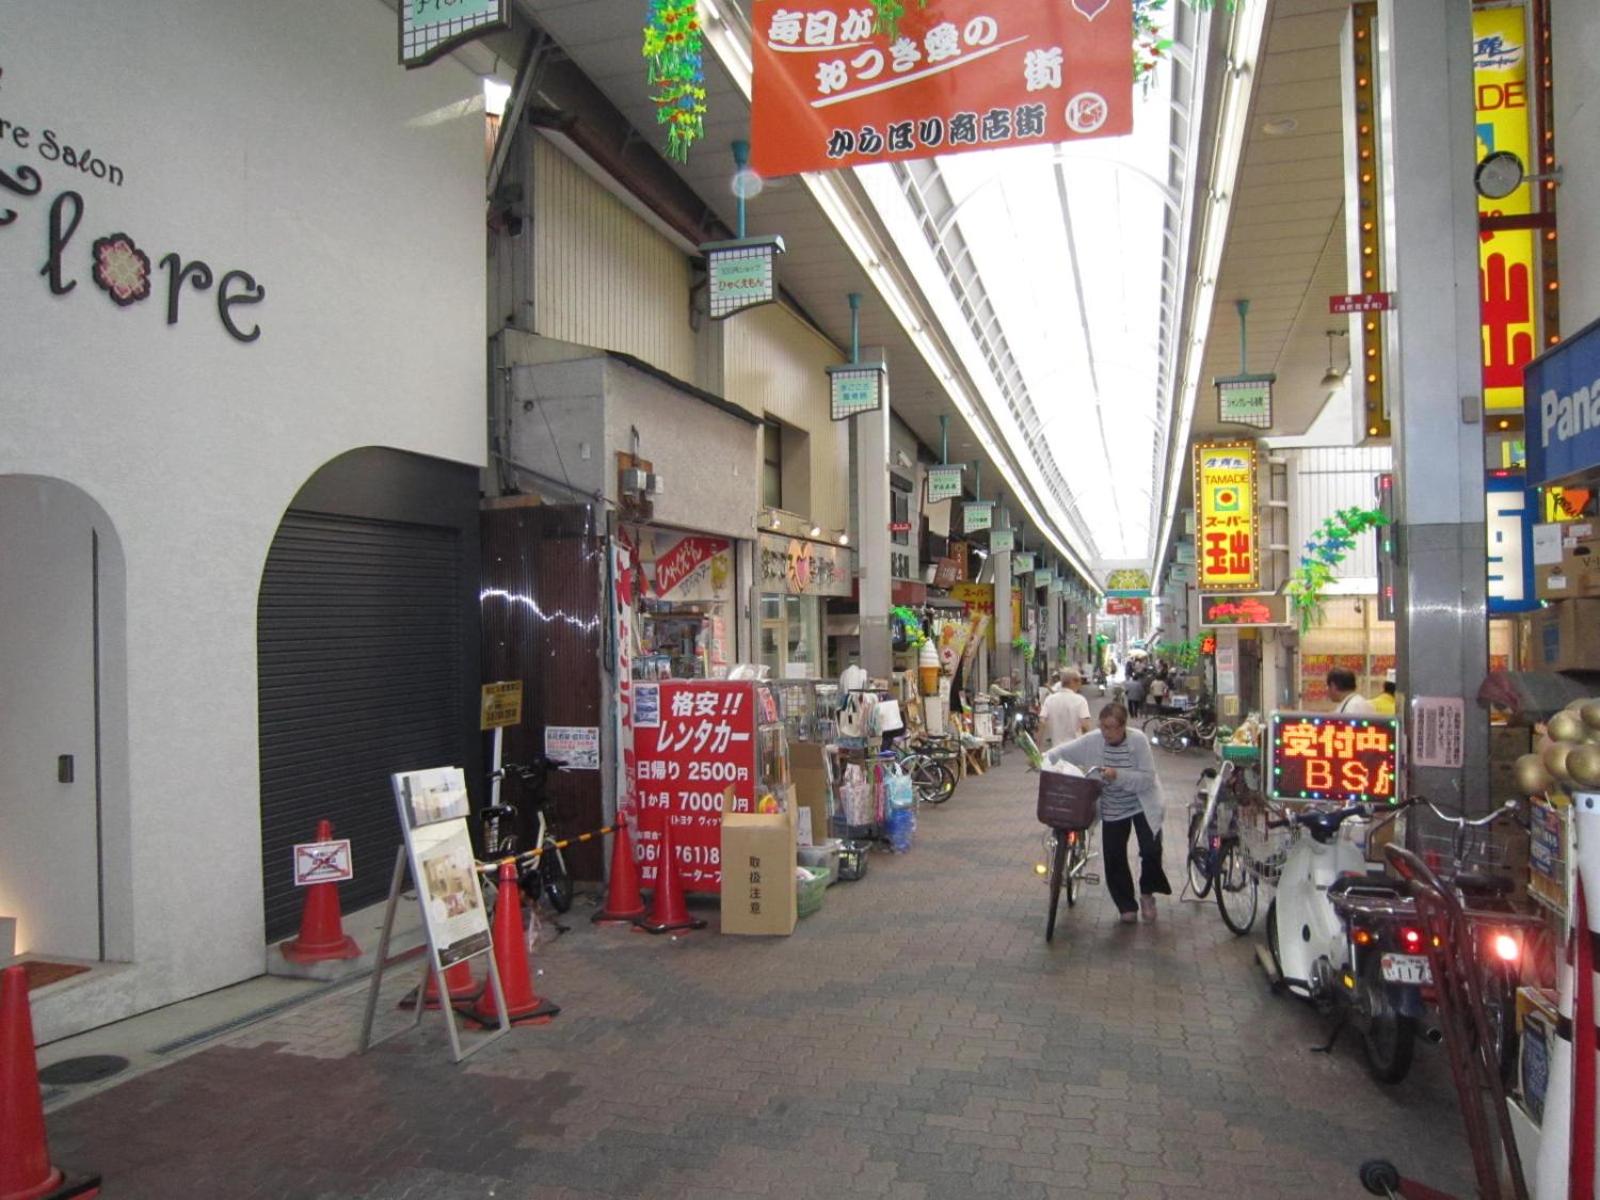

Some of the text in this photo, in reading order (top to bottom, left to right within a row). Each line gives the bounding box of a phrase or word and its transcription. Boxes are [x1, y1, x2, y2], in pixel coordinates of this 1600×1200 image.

[768, 9, 873, 45] 毎日が
[1024, 47, 1063, 91] 街
[1476, 80, 1526, 111] DE
[827, 104, 1047, 159] からほり商店街
[38, 129, 124, 186] Salon
[1205, 474, 1249, 485] TAMADE
[1206, 516, 1250, 528] スーパー
[1206, 530, 1250, 575] 玉出
[657, 719, 750, 754] レンタカー
[1283, 723, 1387, 758] 受付中
[637, 760, 748, 781] 日帰り 2500円
[639, 791, 749, 812] 1か月 7000円
[749, 856, 761, 915] 取扱注意
